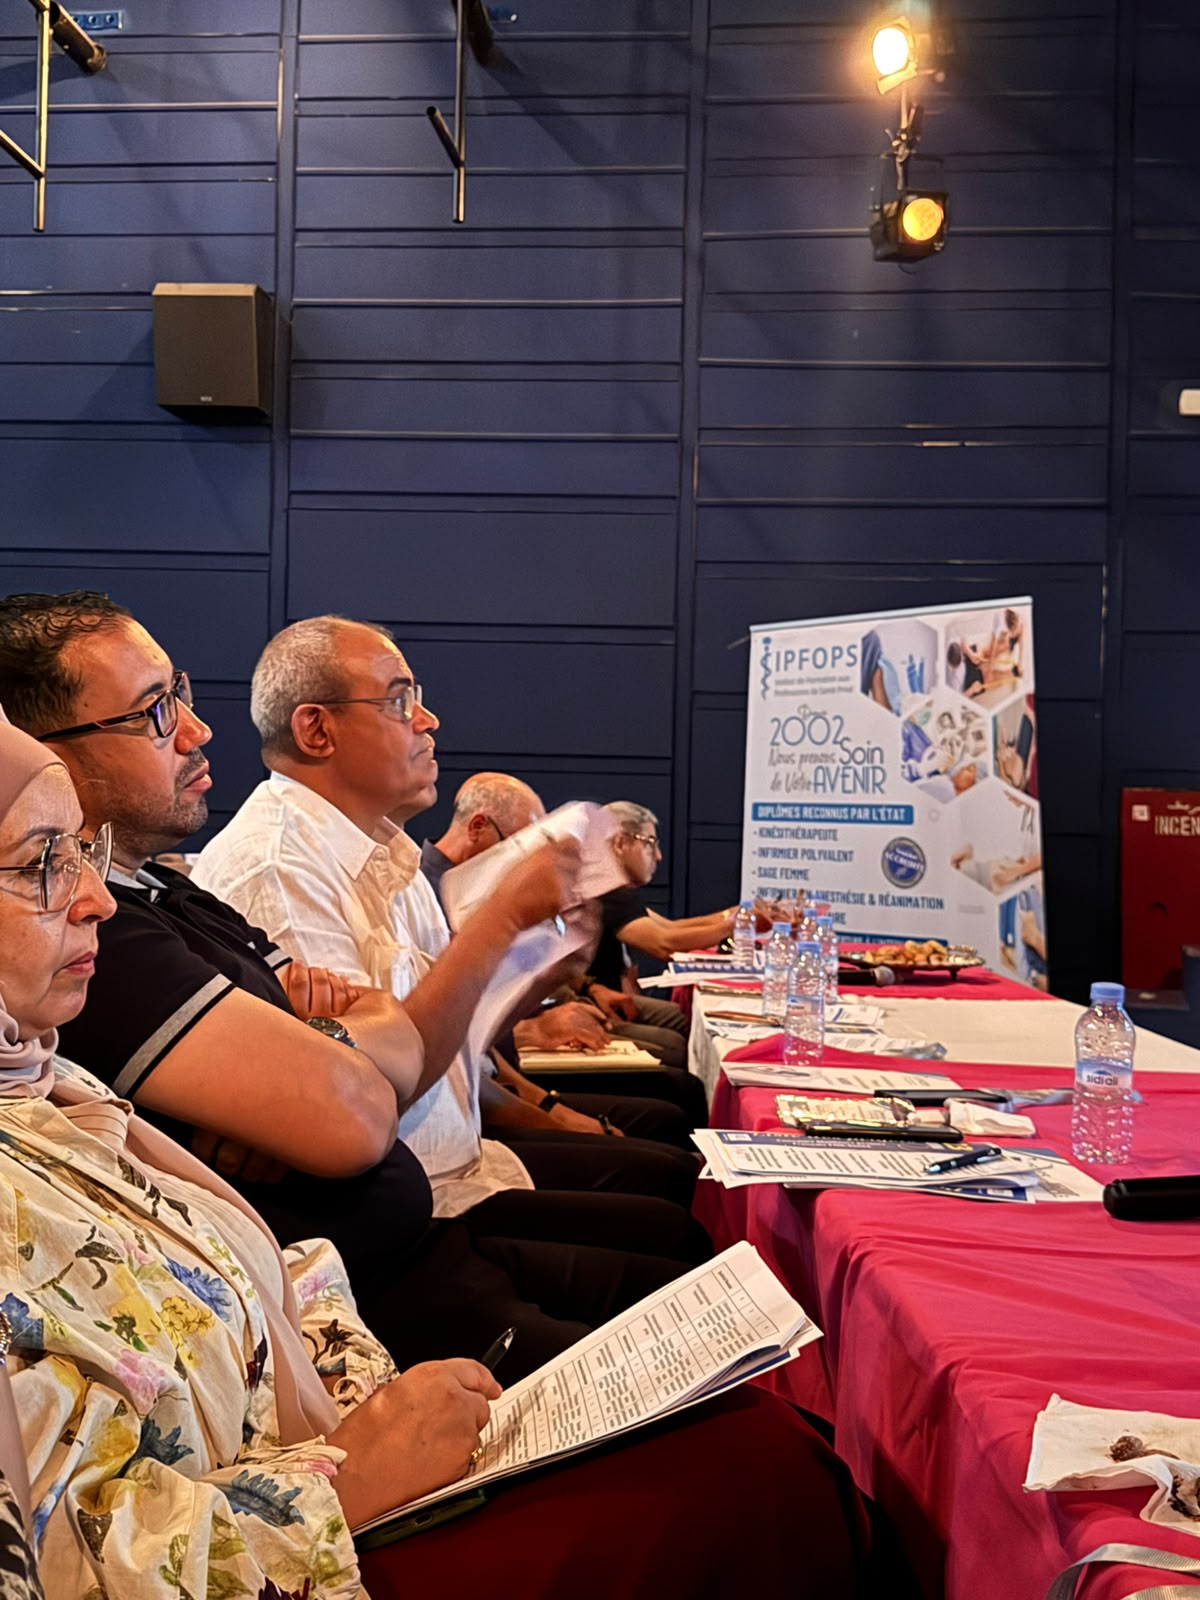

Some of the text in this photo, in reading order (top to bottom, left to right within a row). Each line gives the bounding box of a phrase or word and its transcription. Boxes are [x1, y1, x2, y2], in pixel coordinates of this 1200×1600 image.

[776, 644, 858, 672] IPFOPS
[770, 715, 844, 746] 2002
[839, 736, 884, 765] Soin
[813, 765, 887, 794] AVENIR
[850, 807, 871, 821] PAR
[801, 848, 854, 862] POLYVALENT
[757, 867, 810, 881] SAGE FEMME
[868, 893, 876, 906] &
[878, 892, 945, 910] RÉANIMATION
